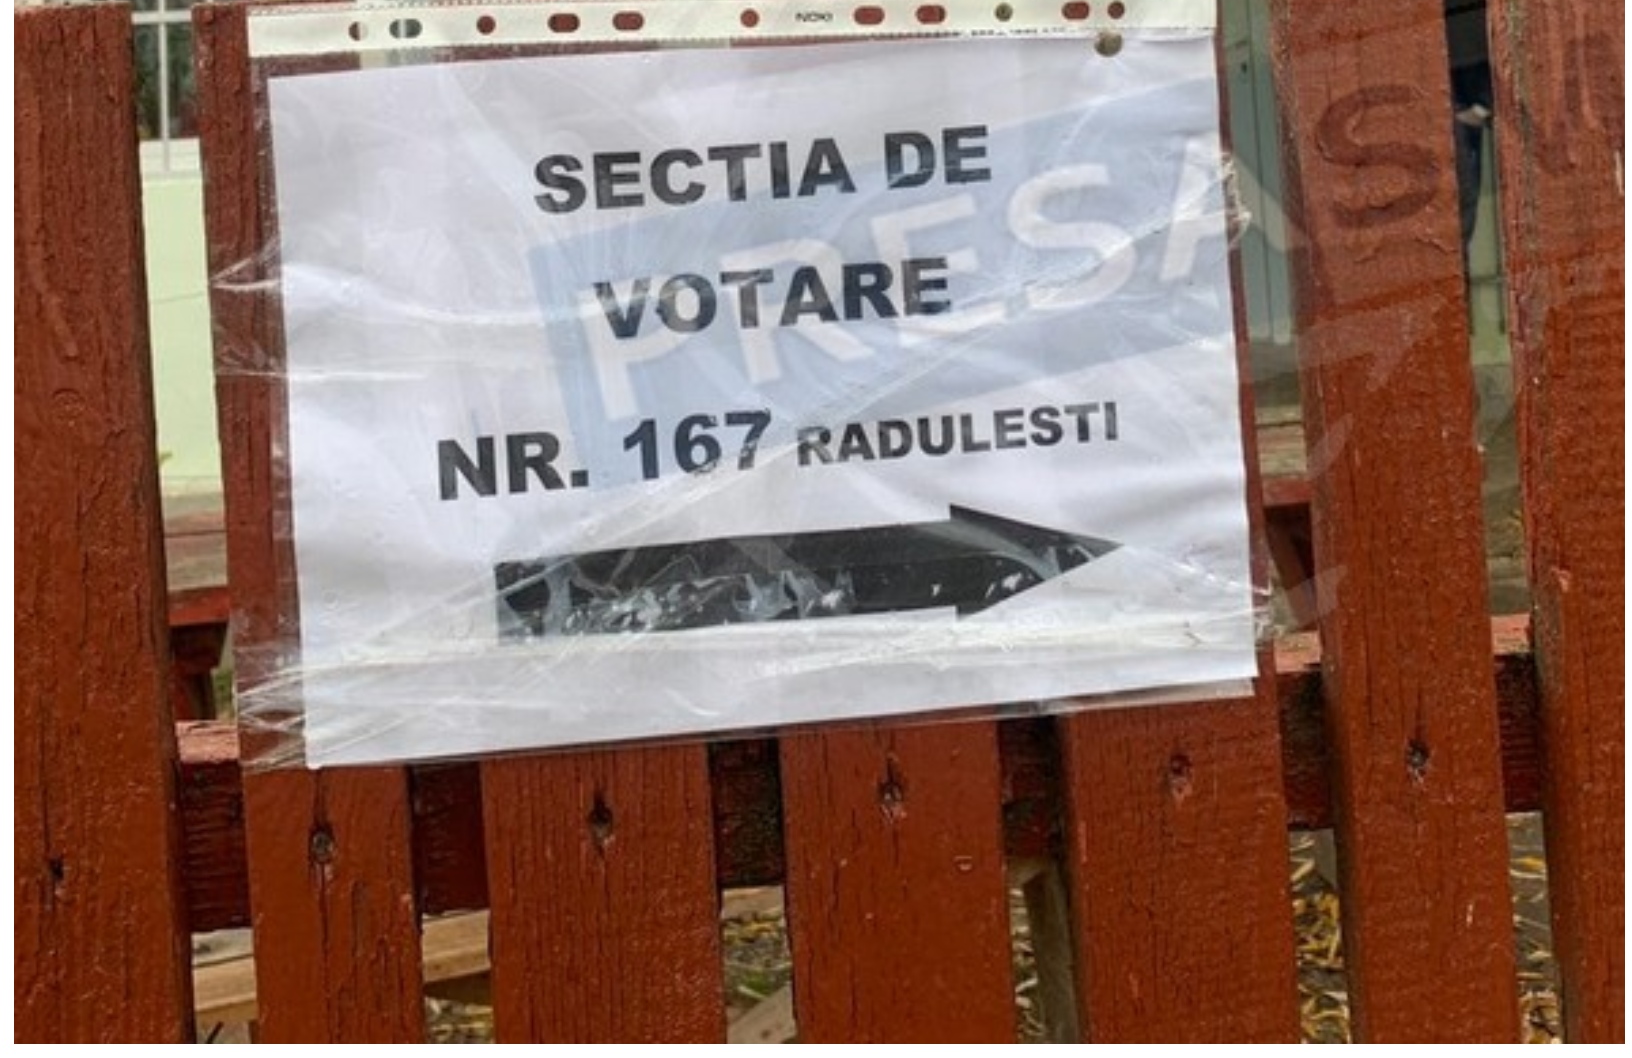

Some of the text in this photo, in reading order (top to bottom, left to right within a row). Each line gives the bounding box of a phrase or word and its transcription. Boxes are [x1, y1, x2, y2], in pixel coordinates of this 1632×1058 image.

[534, 125, 991, 214] SECTIA DE
[592, 257, 952, 340] VOTARE
[437, 400, 1118, 500] NR. 167 RADULESTI
